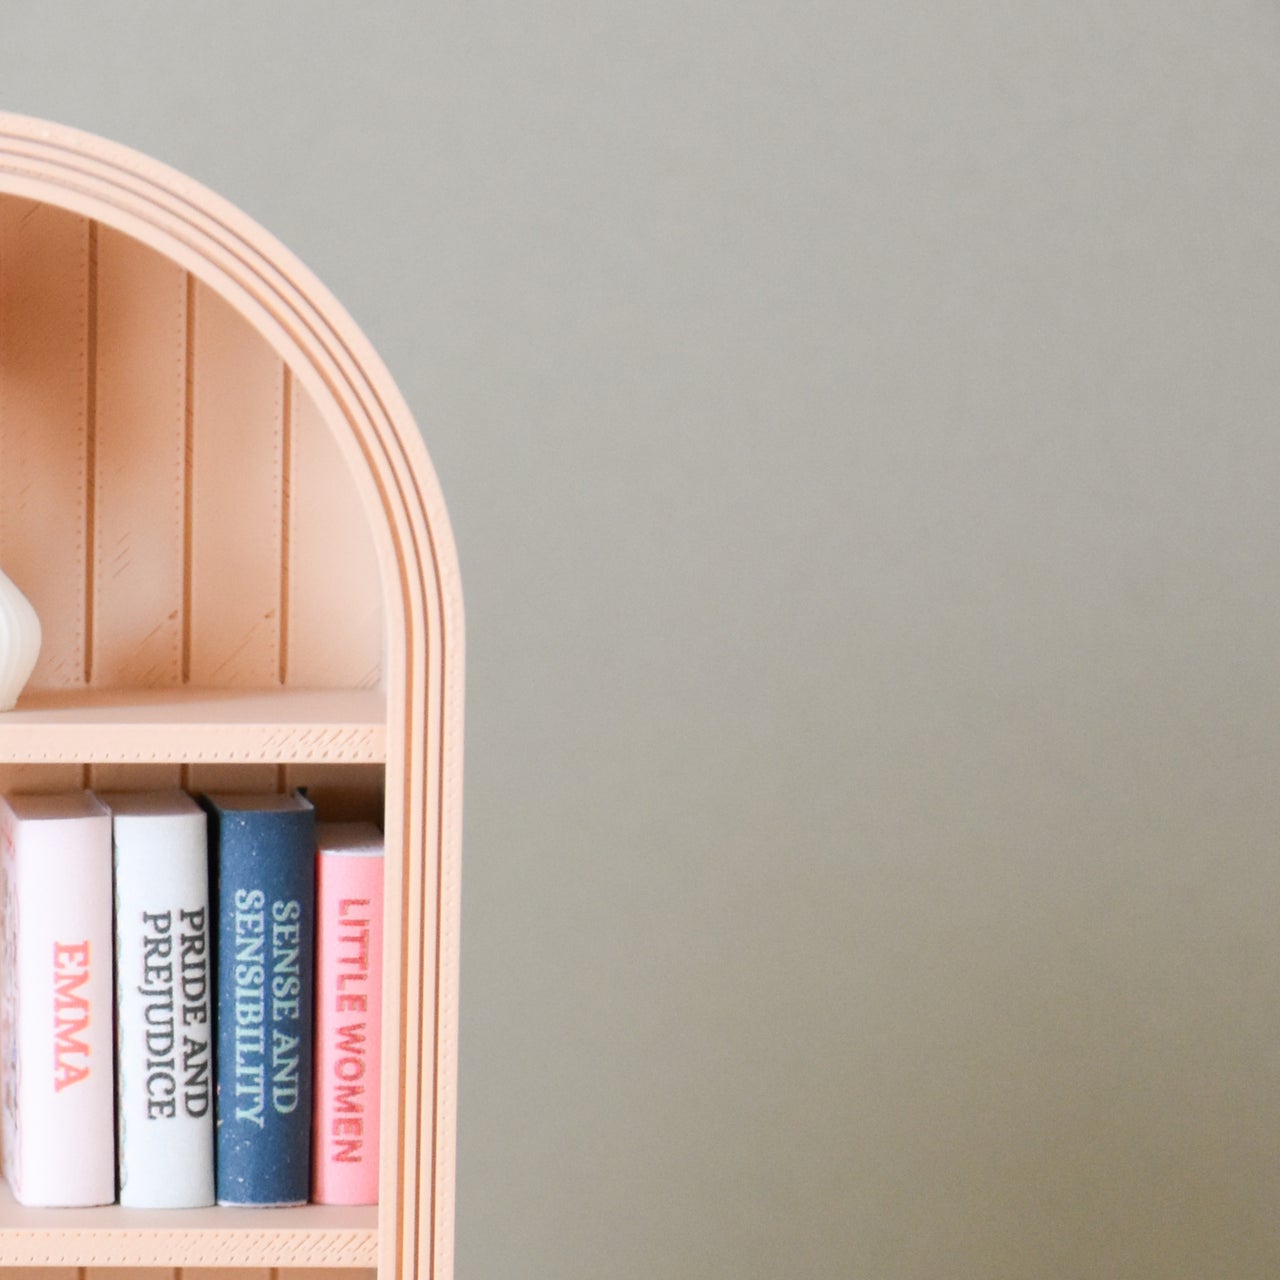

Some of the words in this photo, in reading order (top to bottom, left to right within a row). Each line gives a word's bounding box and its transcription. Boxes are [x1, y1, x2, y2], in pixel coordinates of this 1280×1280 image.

[53, 939, 92, 1093] EMMA
[138, 910, 177, 1122] PREJUDICE
[180, 906, 208, 1028] PRIDE
[234, 888, 266, 1129] SENSIBILITY
[271, 899, 301, 1022] SENSE
[335, 897, 371, 1013] LITTLE
[181, 1034, 210, 1120] AND
[271, 1029, 300, 1115] AND
[331, 1023, 368, 1164] WOMEN
